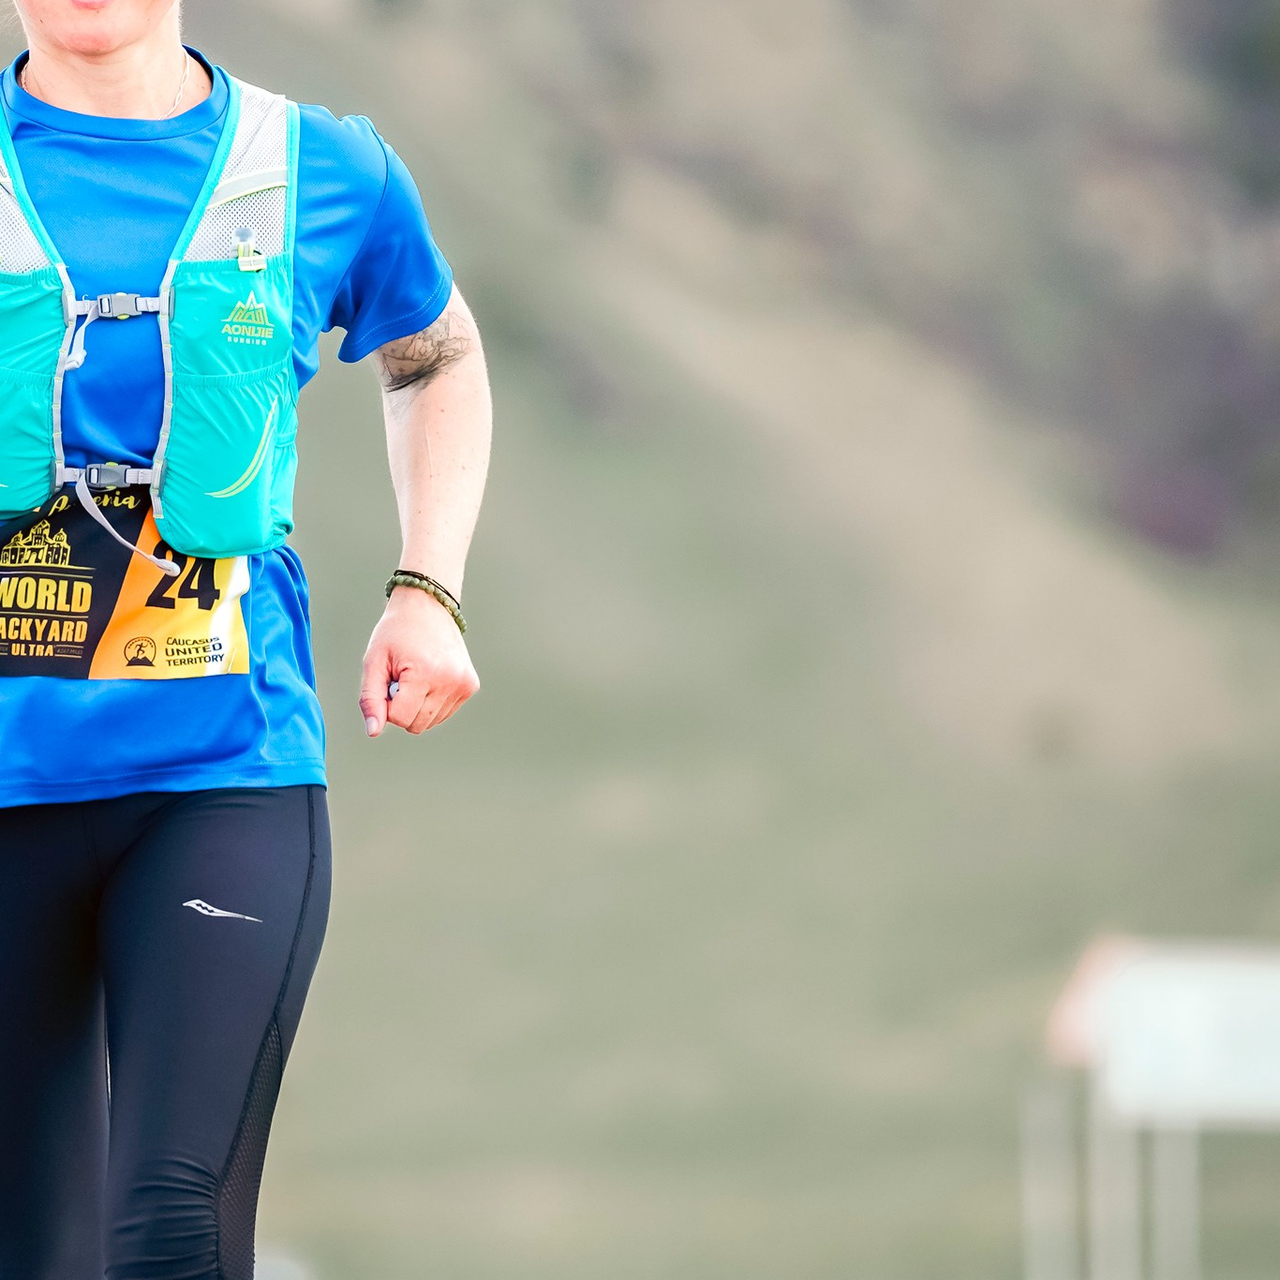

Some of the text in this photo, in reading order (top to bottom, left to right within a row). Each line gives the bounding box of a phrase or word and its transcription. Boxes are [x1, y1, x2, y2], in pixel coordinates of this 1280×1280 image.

[221, 323, 274, 338] AONIJIE
[48, 490, 140, 517] Aenia
[145, 540, 220, 610] 24
[166, 636, 220, 646] CAUCASUS
[11, 643, 54, 656] ULTRA
[165, 643, 223, 657] UNITED
[166, 654, 225, 667] TERRITORY
